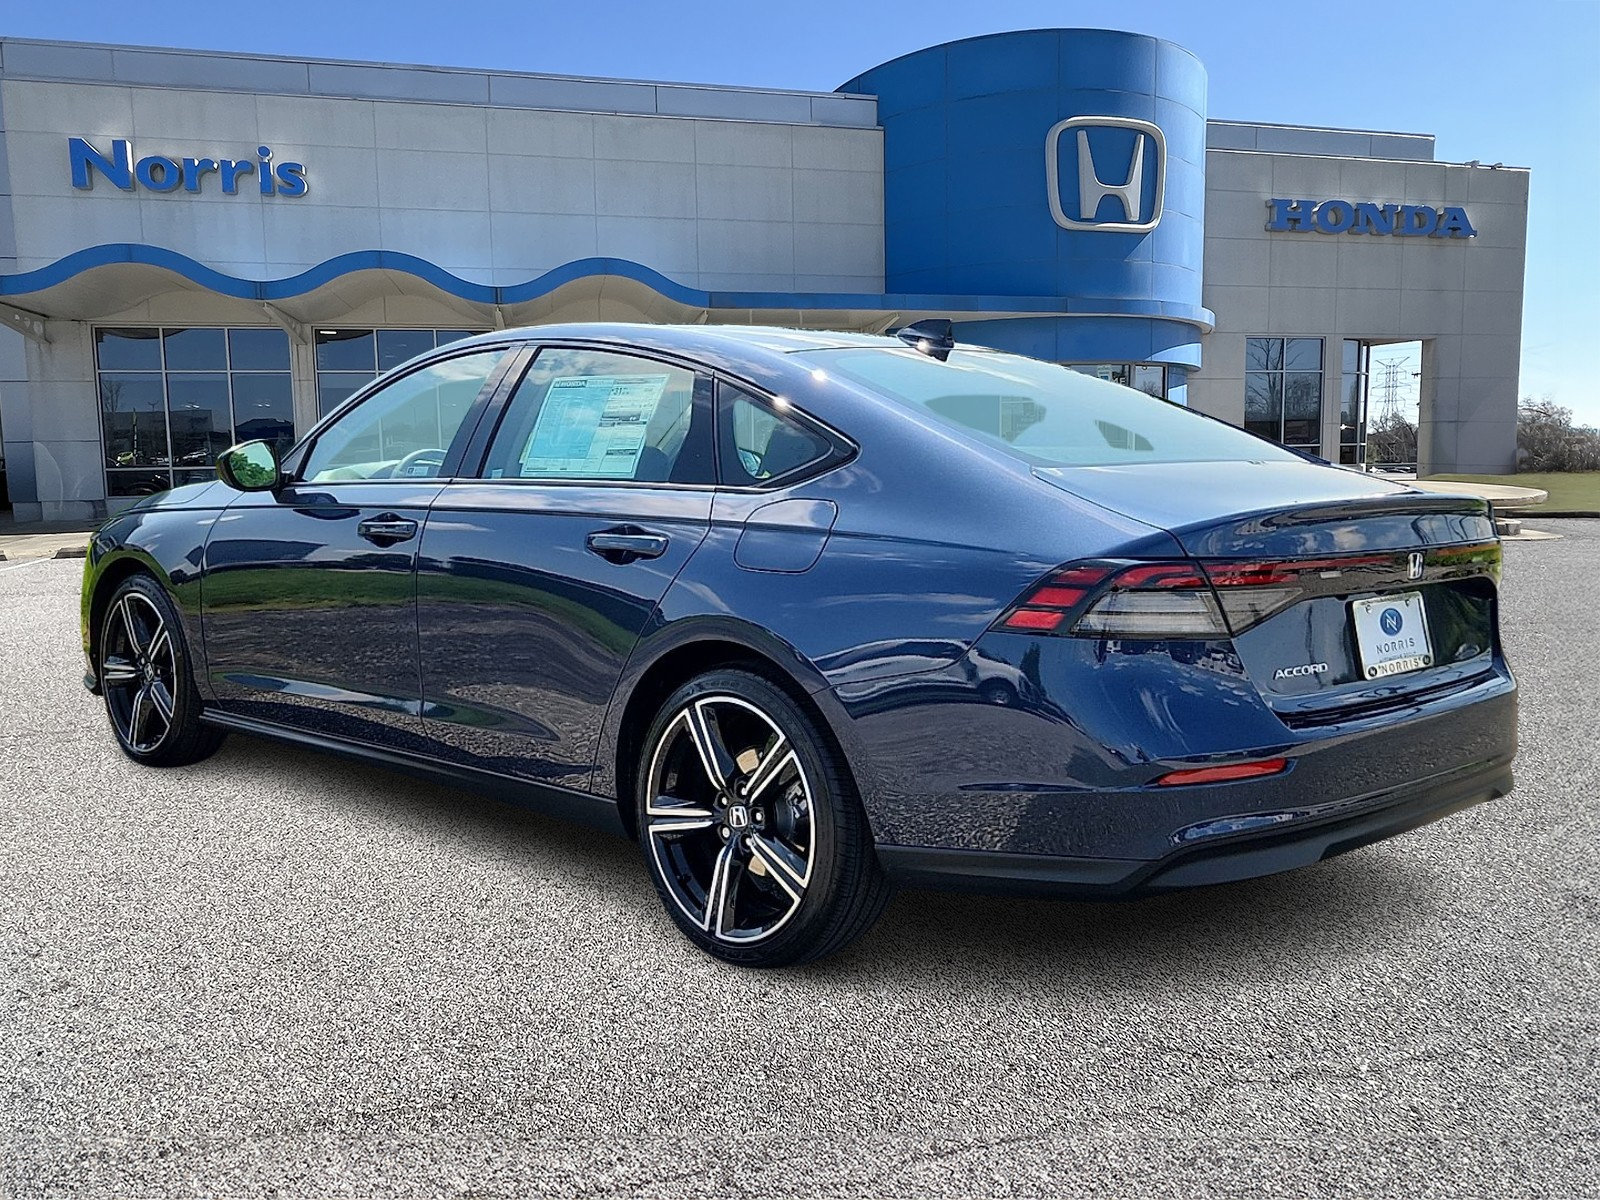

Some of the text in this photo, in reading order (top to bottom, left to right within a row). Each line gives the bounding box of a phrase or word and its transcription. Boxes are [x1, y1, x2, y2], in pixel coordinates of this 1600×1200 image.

[68, 137, 309, 197] Norris
[1265, 198, 1478, 238] HONDA
[1375, 637, 1416, 655] NORRIS
[1273, 662, 1329, 680] ACCORD
